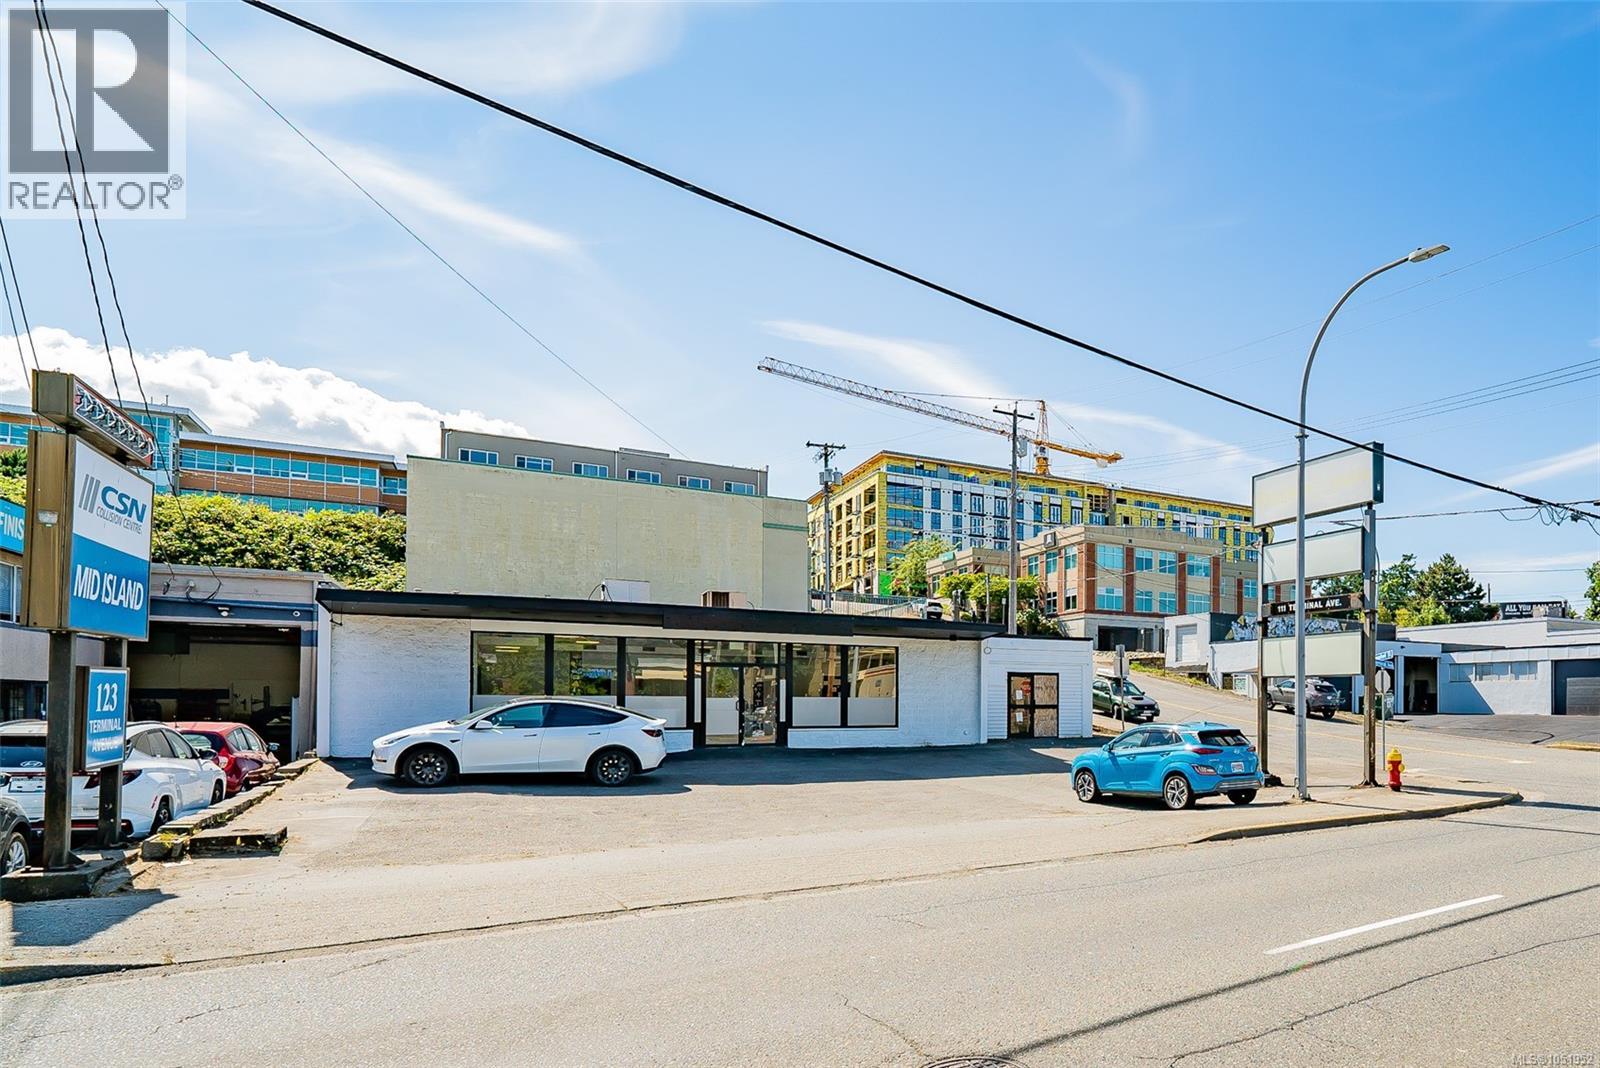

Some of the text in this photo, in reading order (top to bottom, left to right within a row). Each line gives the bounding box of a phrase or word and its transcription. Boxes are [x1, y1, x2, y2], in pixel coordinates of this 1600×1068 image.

[100, 485, 147, 523] CSN
[96, 506, 142, 535] COLLISION CENTRE
[73, 564, 144, 611] MID ISLAND
[1277, 605, 1286, 613] 111
[1325, 598, 1342, 608] AVE.
[96, 683, 118, 711] 123
[89, 718, 121, 733] TERMINAL
